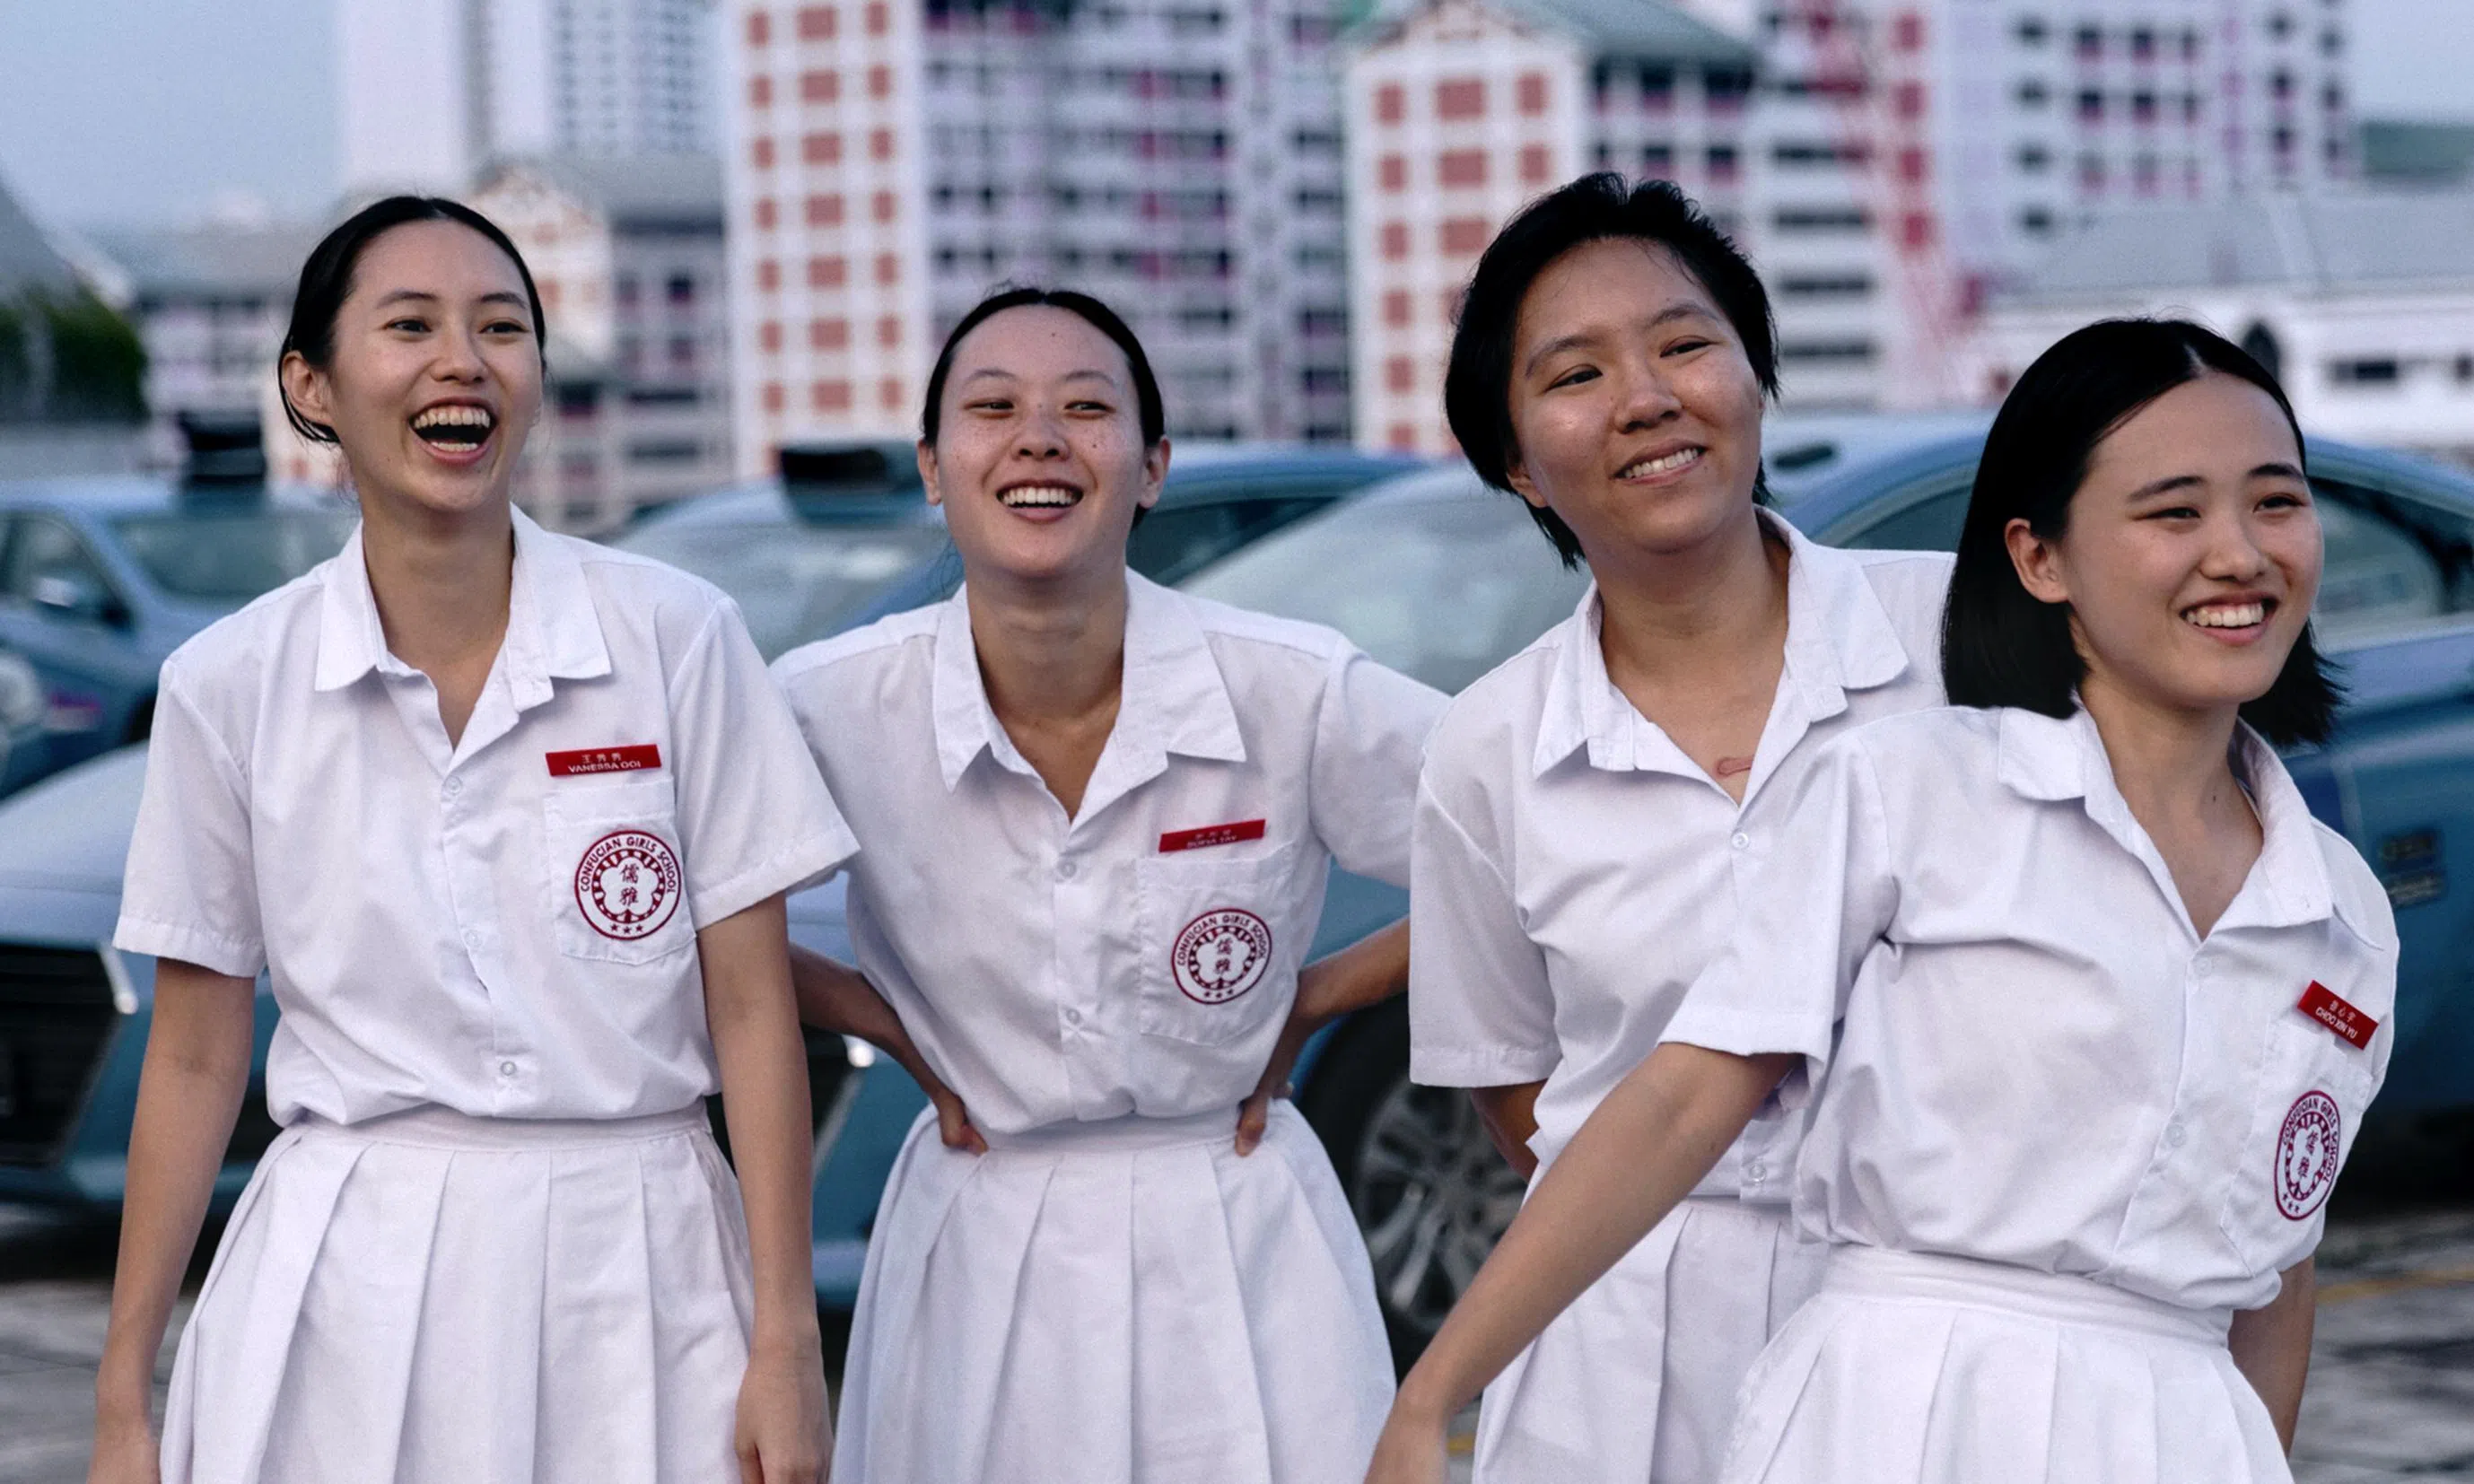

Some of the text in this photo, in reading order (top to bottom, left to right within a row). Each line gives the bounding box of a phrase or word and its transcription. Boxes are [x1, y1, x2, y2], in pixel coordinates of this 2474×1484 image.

[567, 760, 642, 773] VANESSA OOI
[581, 836, 677, 894] CONFUCIAN GIRLS SCHOOL
[1176, 914, 1267, 965] CONFUCIAN GIRLS SCHOOL
[2315, 1006, 2337, 1025] CHOO
[2347, 1026, 2358, 1039] YU
[2282, 1097, 2319, 1146] CONFUCIAN
